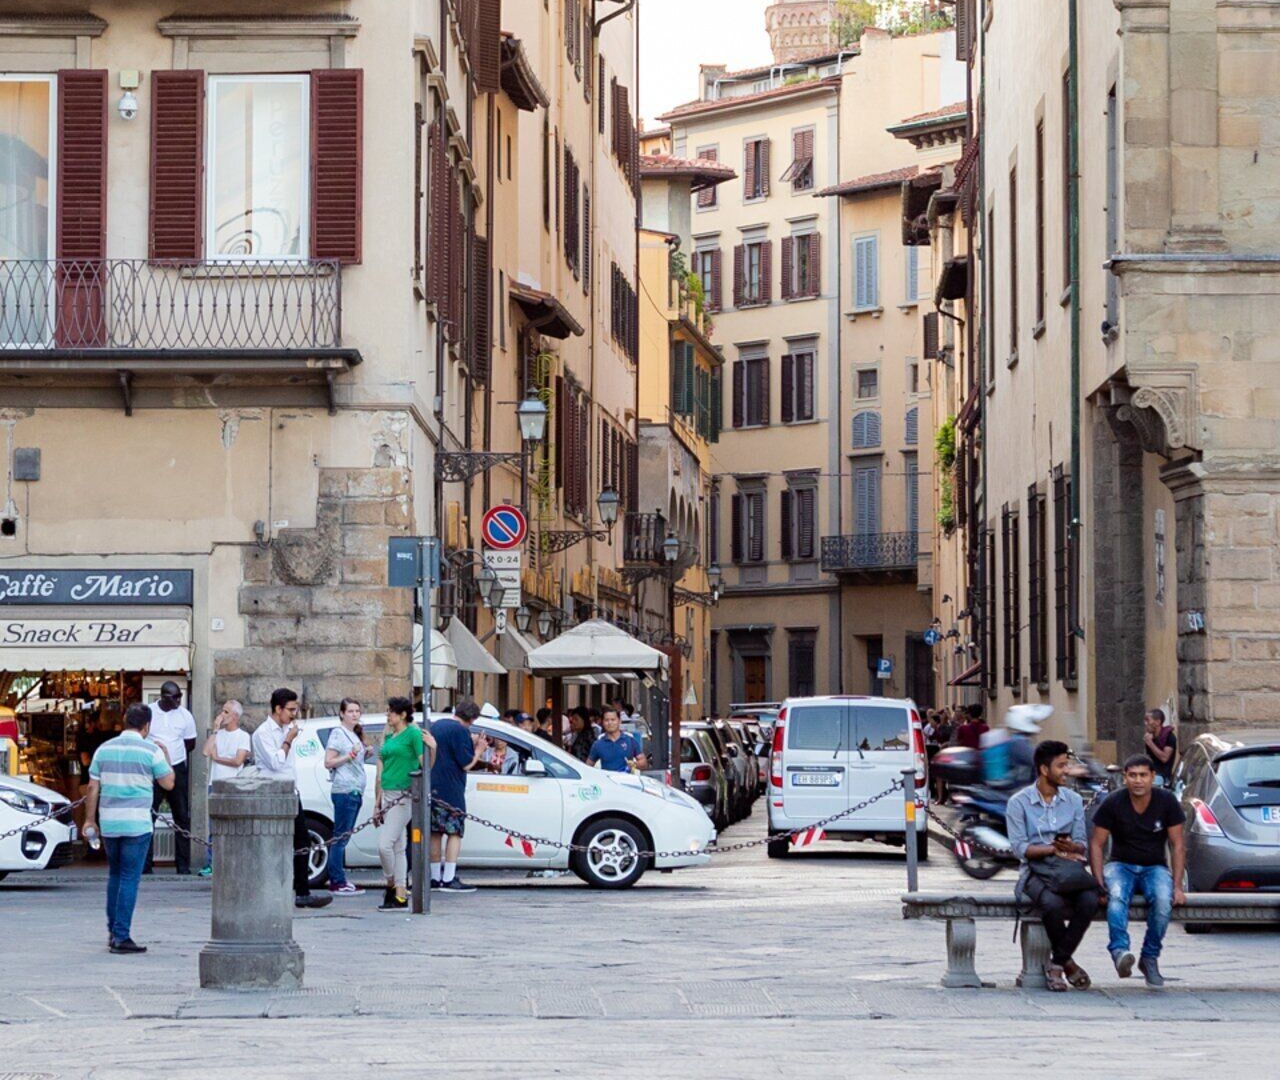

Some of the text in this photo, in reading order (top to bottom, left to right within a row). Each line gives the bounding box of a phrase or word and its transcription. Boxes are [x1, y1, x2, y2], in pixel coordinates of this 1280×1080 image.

[70, 575, 174, 601] Mario
[3, 622, 152, 643] Snack Bar
[881, 660, 890, 671] P
